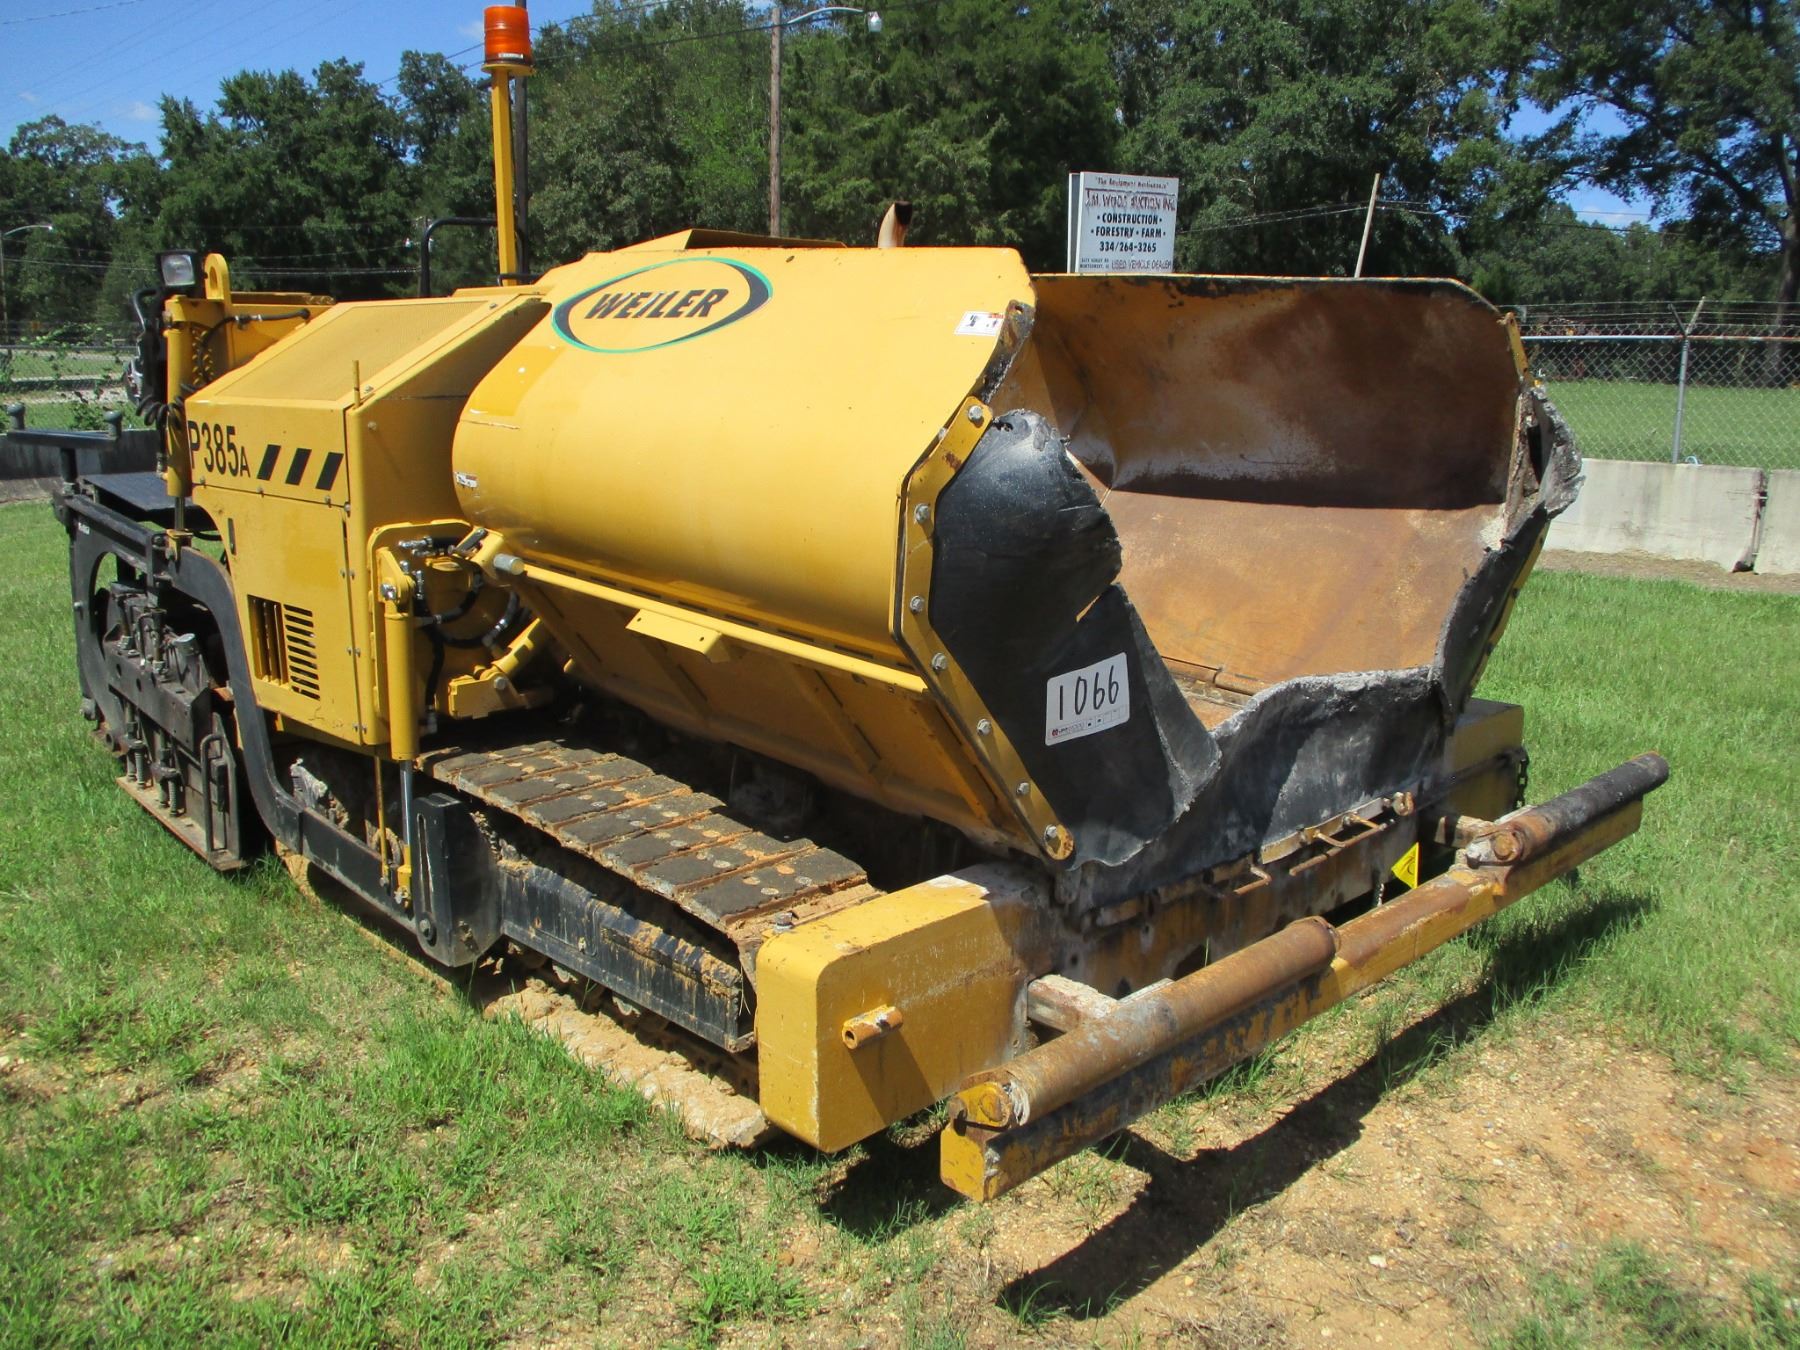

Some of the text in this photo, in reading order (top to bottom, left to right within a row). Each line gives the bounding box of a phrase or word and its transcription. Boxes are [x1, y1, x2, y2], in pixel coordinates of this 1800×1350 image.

[1102, 213, 1158, 225] CONSTRUCTION
[1095, 226, 1162, 238] FORESTRY FARM
[1099, 241, 1157, 252] 334/264-3265
[584, 288, 729, 319] WEILER
[187, 420, 251, 478] P385A
[1059, 665, 1119, 720] 1066
